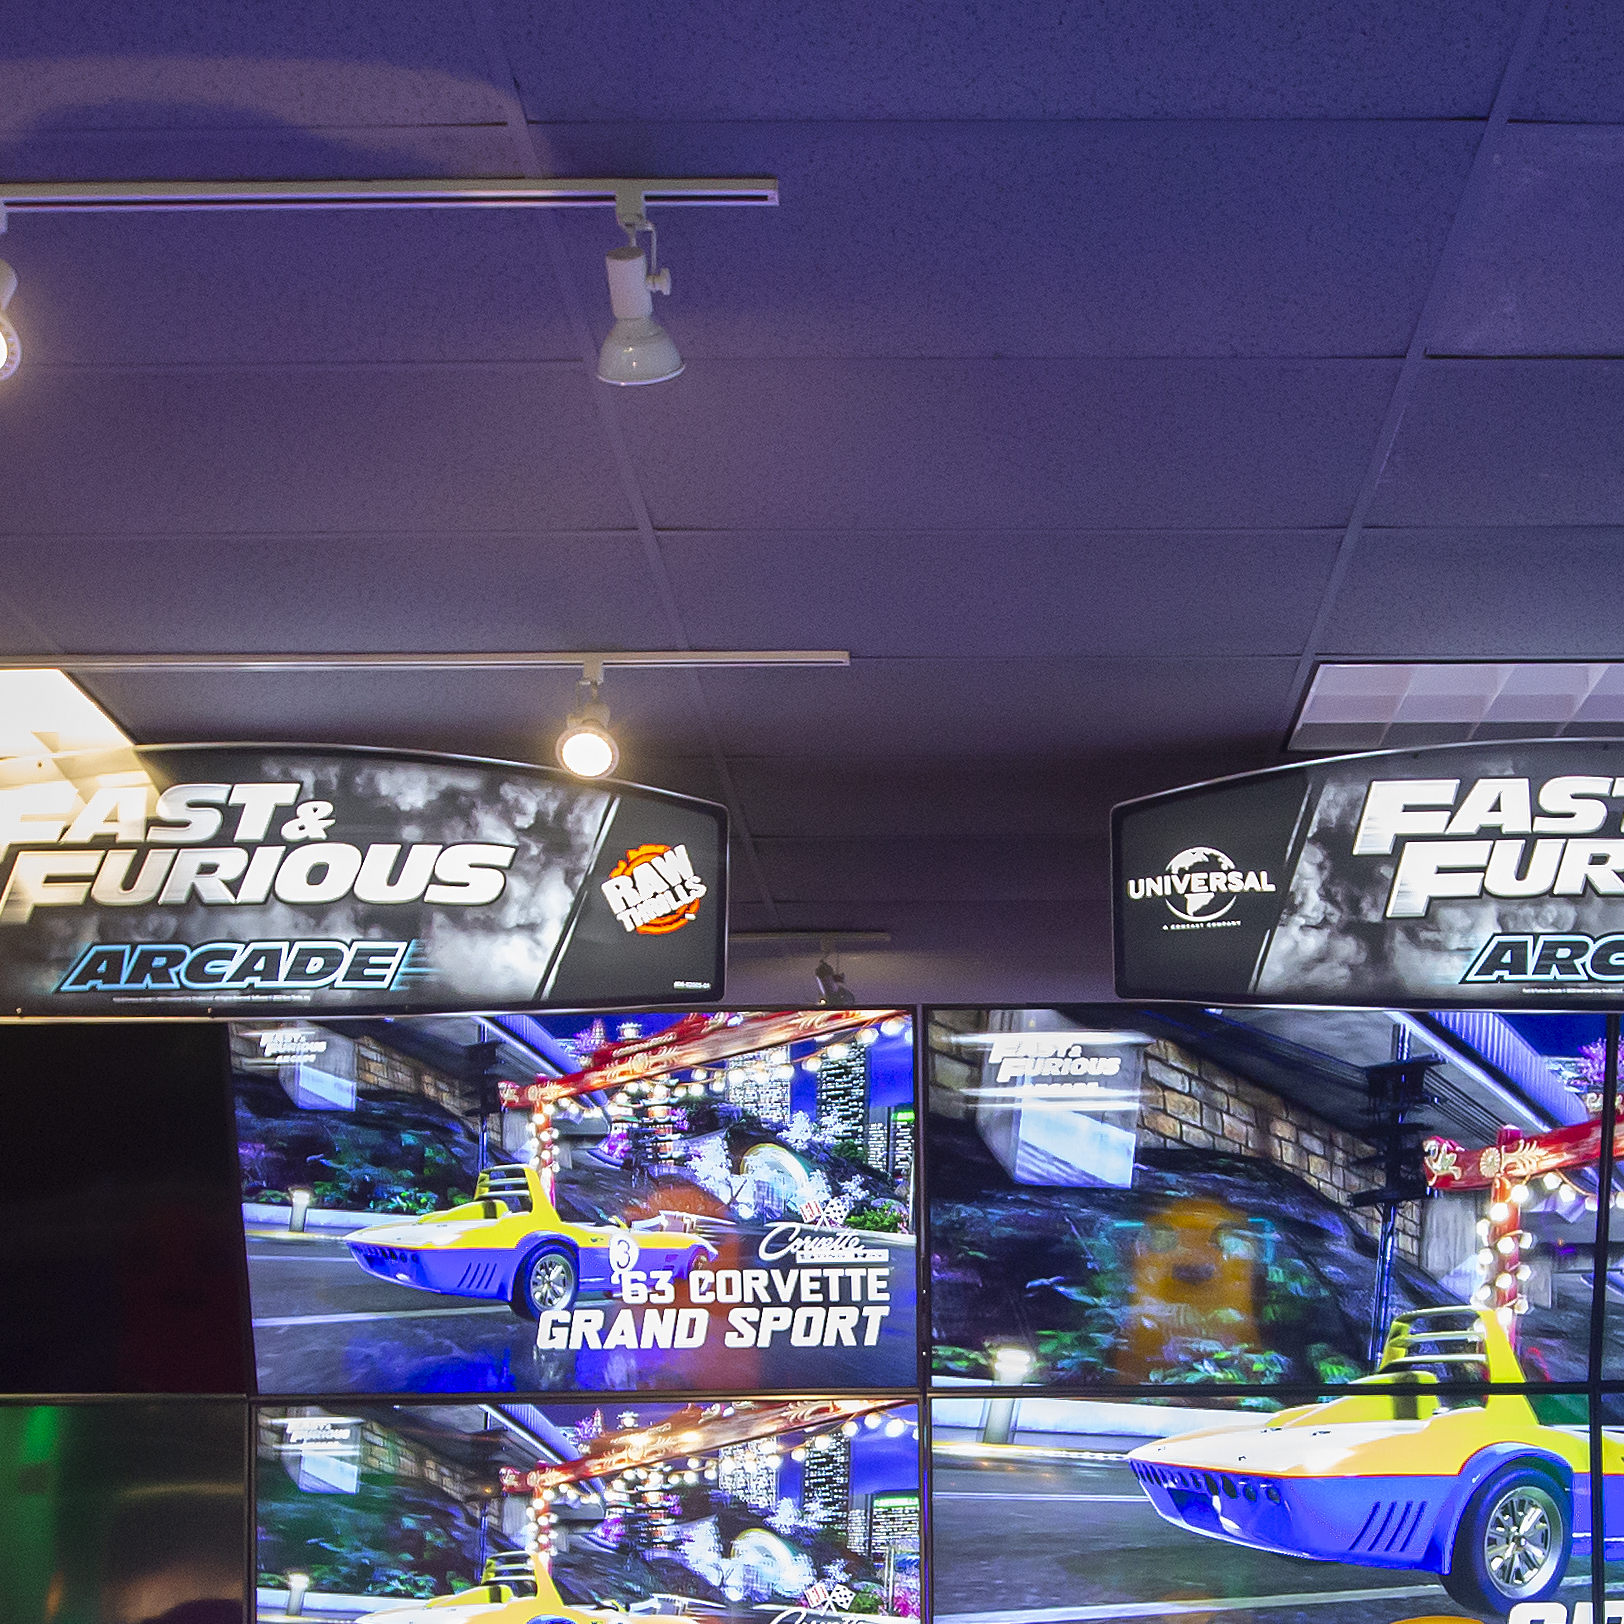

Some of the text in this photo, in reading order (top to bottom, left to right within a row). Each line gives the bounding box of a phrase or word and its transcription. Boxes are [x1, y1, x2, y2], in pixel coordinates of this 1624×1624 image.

[281, 801, 335, 841] &
[601, 844, 694, 914] RAW
[1128, 871, 1276, 900] UNIVERSAL
[616, 876, 707, 932] THRILLS
[57, 939, 416, 991] ARCADE
[996, 1057, 1121, 1083] FURIOUS
[615, 1240, 630, 1269] 3
[758, 1225, 864, 1261] Corvette
[689, 1268, 891, 1304] CORVETTE
[536, 1306, 891, 1349] GRAND SPORT
